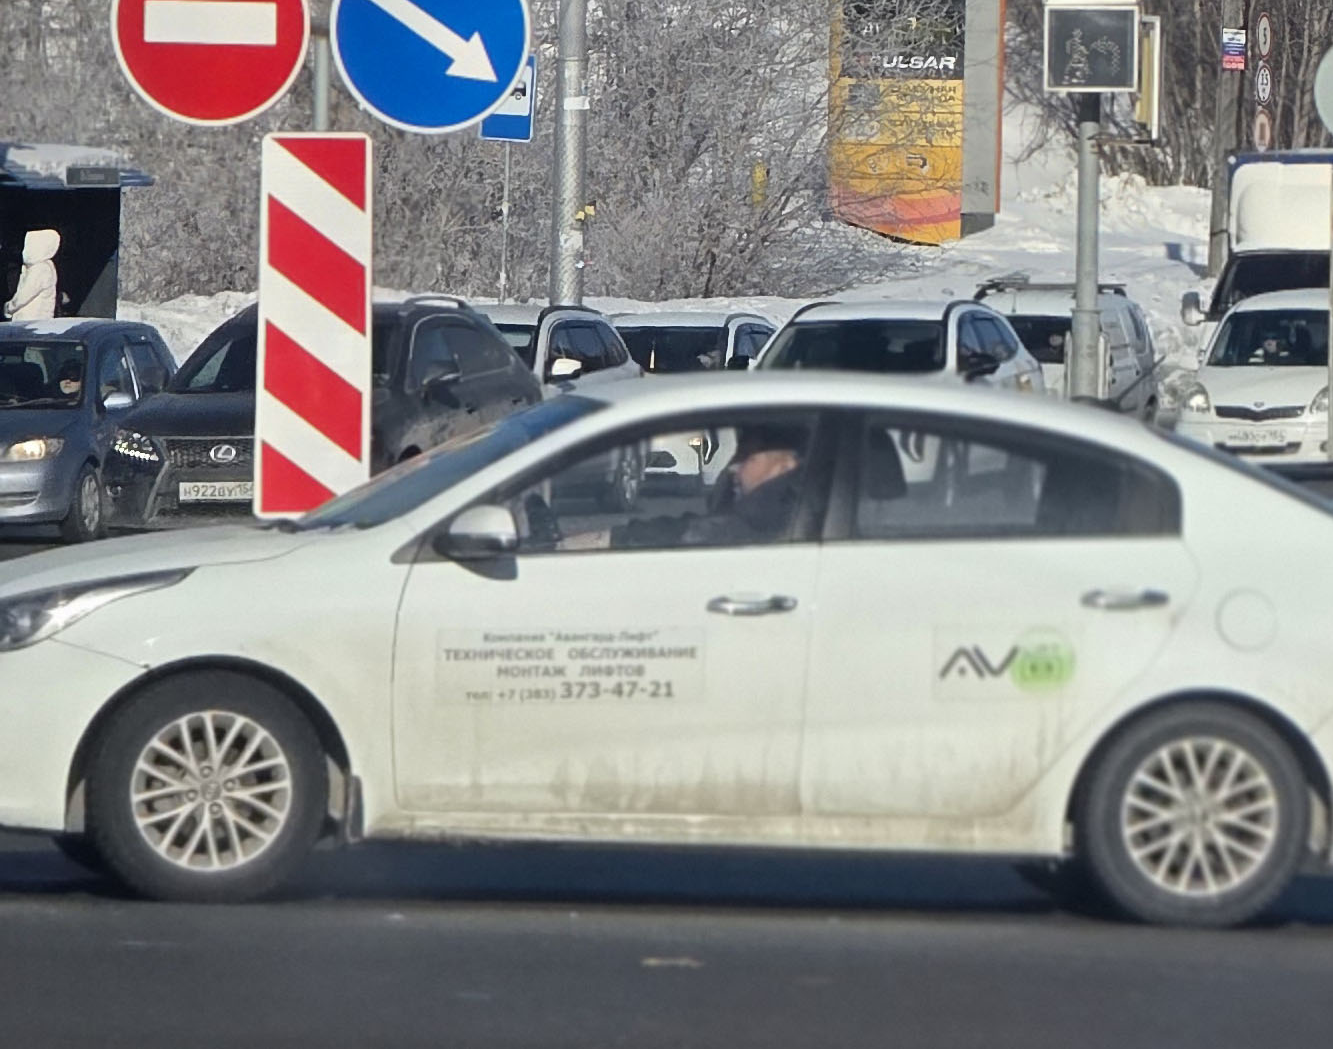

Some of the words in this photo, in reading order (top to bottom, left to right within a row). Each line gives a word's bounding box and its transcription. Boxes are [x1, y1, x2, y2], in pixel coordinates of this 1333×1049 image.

[444, 647, 555, 661] ТЕХНИЧЕСКОЕ
[567, 646, 698, 660] ОБСЛУЖИВАНИЕ
[496, 664, 567, 678] МОНТАЖ
[578, 664, 646, 678] ЛИФТОВ
[496, 689, 516, 701] +7
[519, 687, 557, 703] (383)
[560, 681, 675, 700] 373-47-21
